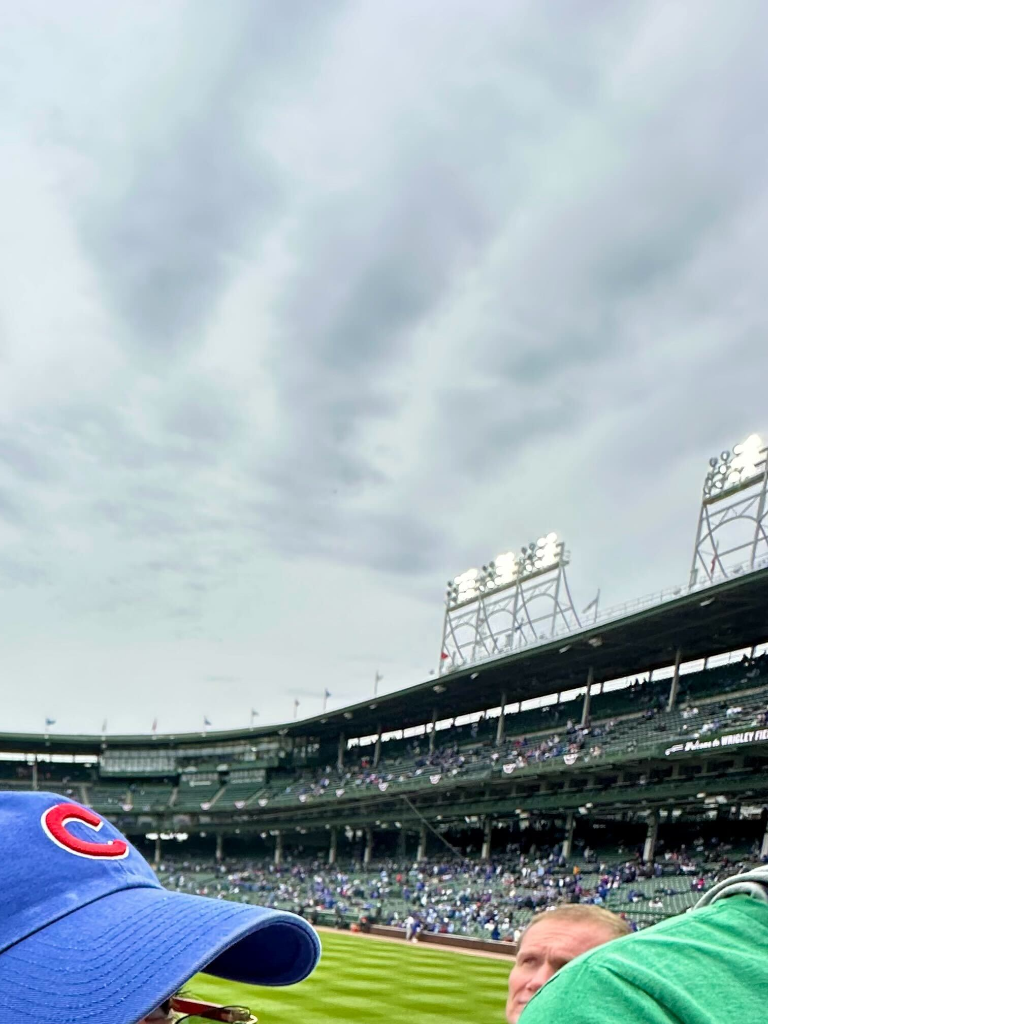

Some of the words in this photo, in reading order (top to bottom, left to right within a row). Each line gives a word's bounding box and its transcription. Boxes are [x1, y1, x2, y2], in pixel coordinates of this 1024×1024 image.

[721, 731, 754, 746] WRIGLEY
[755, 729, 768, 741] FIE
[40, 802, 130, 861] C
